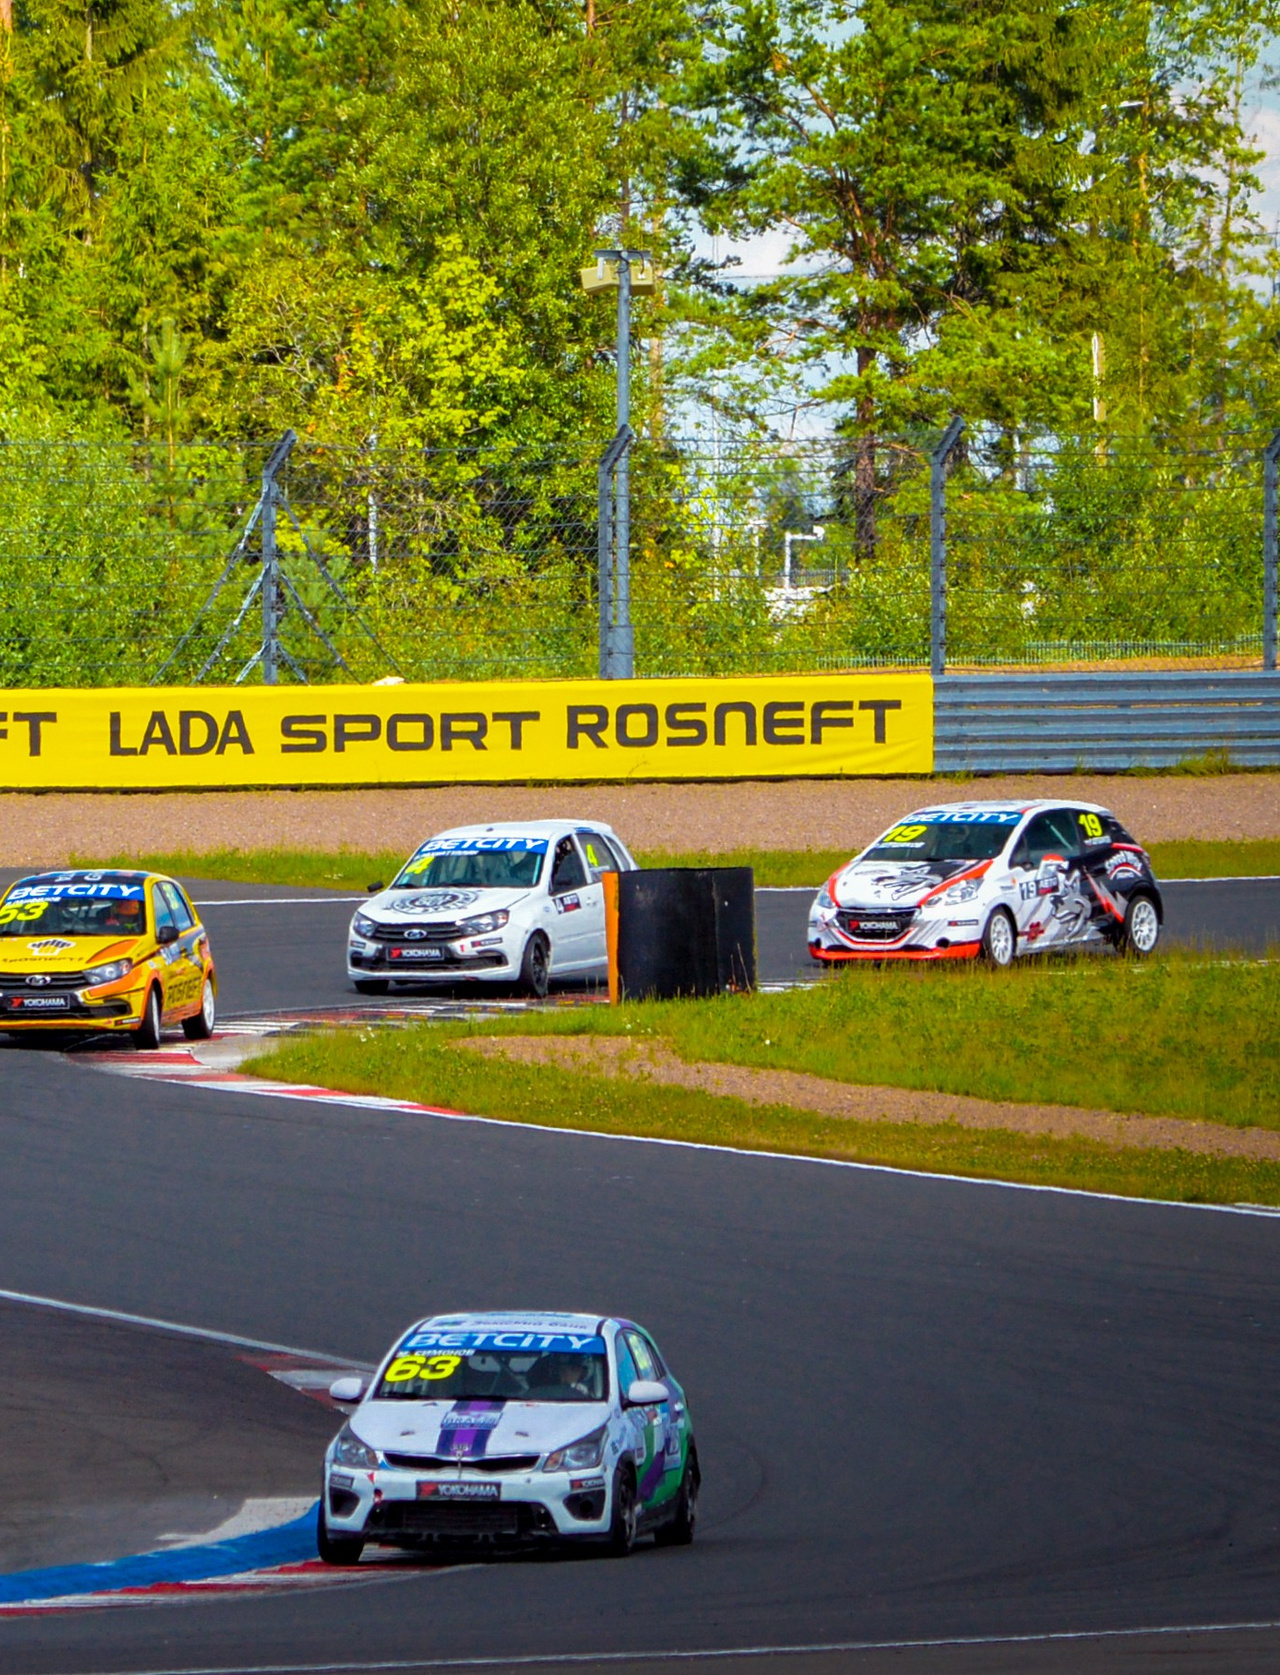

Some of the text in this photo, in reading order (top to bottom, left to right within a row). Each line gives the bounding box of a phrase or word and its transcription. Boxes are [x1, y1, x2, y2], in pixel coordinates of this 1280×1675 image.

[109, 711, 255, 757] LADA
[280, 711, 541, 755] SPORT
[567, 699, 903, 749] ROSNEFT
[883, 824, 928, 843] 19
[1078, 813, 1103, 837] 19
[421, 838, 545, 851] BETCITY
[586, 844, 599, 867] 4
[6, 883, 141, 901] BETCITY
[1020, 881, 1037, 900] 19
[407, 1332, 598, 1349] BETCITY
[384, 1355, 462, 1383] 63
[437, 1484, 499, 1496] YOKOHAMA
